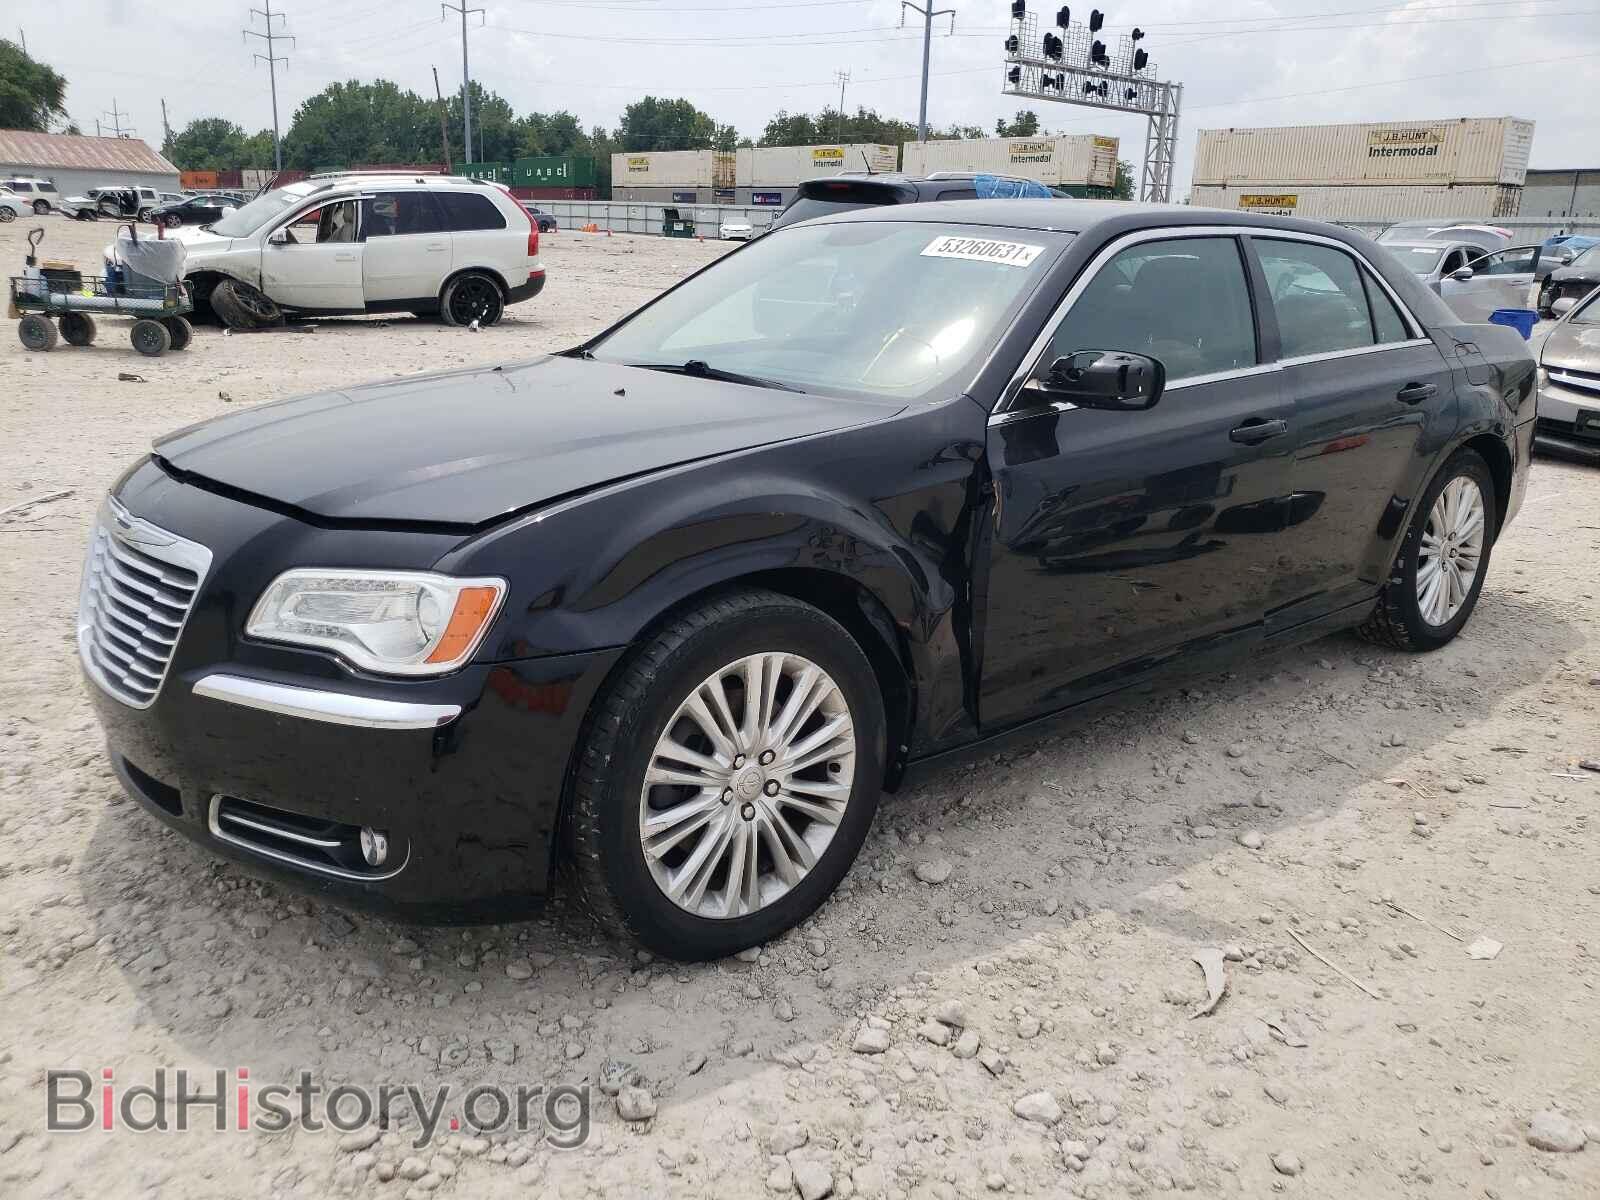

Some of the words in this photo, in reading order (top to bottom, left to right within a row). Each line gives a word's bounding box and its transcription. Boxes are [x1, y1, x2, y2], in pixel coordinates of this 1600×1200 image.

[1368, 144, 1439, 157] Intermodal
[1010, 154, 1051, 163] Intermodal
[938, 238, 1026, 260] 53260631
